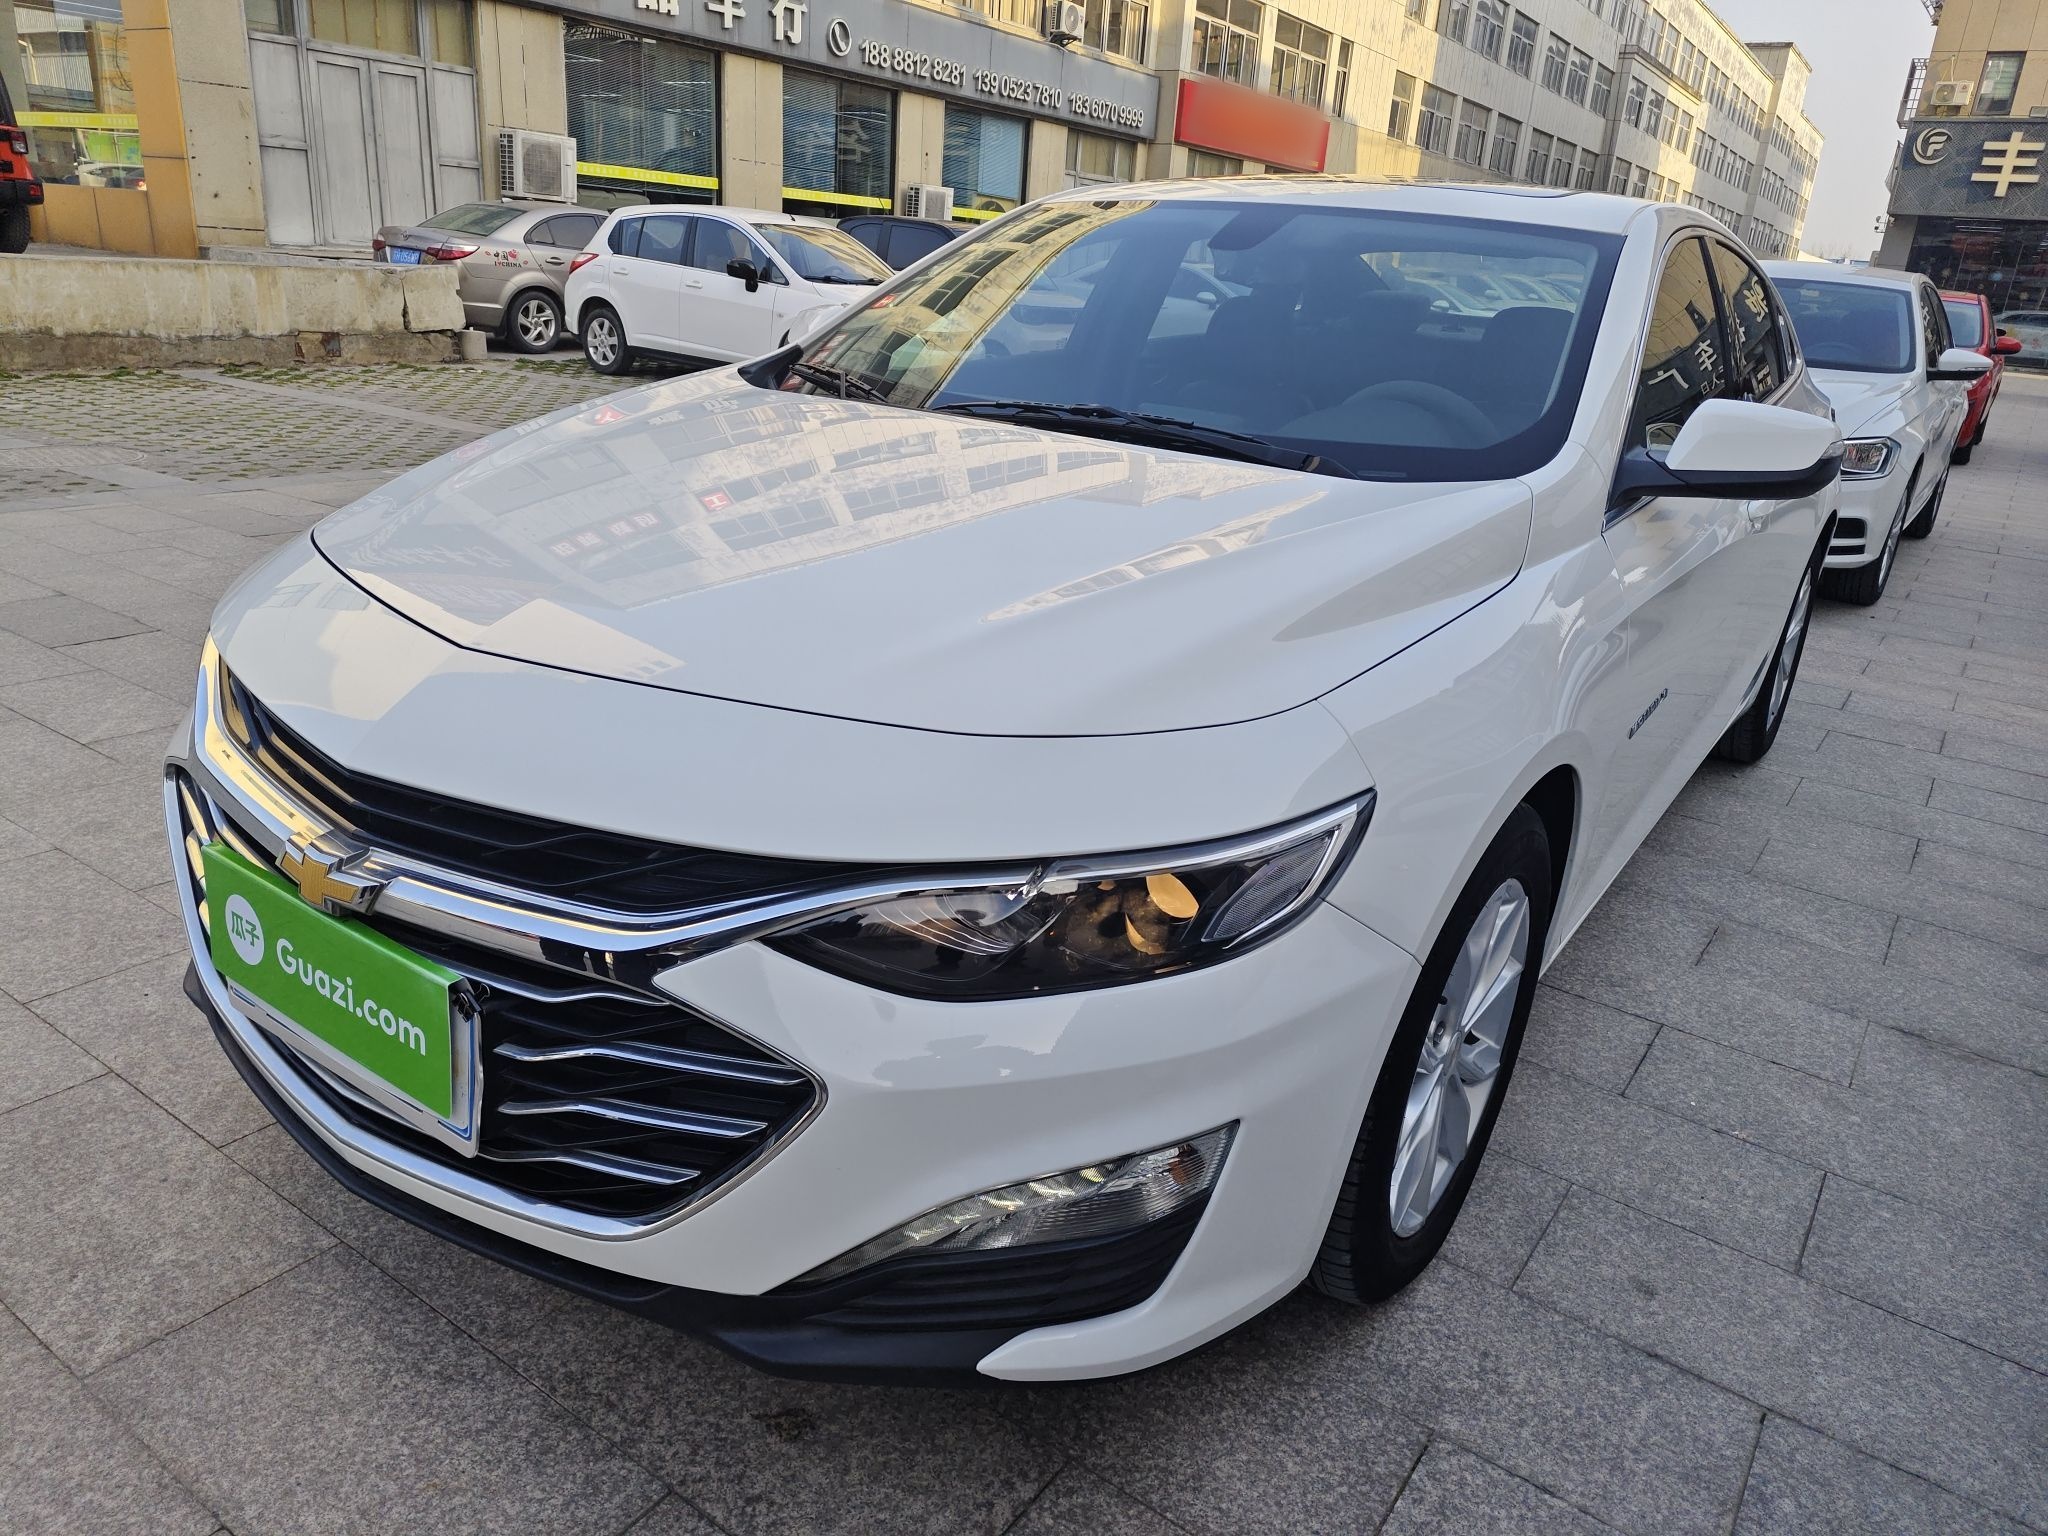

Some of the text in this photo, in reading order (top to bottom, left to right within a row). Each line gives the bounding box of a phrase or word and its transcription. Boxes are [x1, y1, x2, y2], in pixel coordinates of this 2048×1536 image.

[860, 39, 1145, 128] 188 8812 8281 139 0523 7810 183 6070 9999
[1970, 131, 2047, 198] 丰
[231, 910, 260, 948] 瓜子
[276, 938, 426, 1056] Guazi.com
